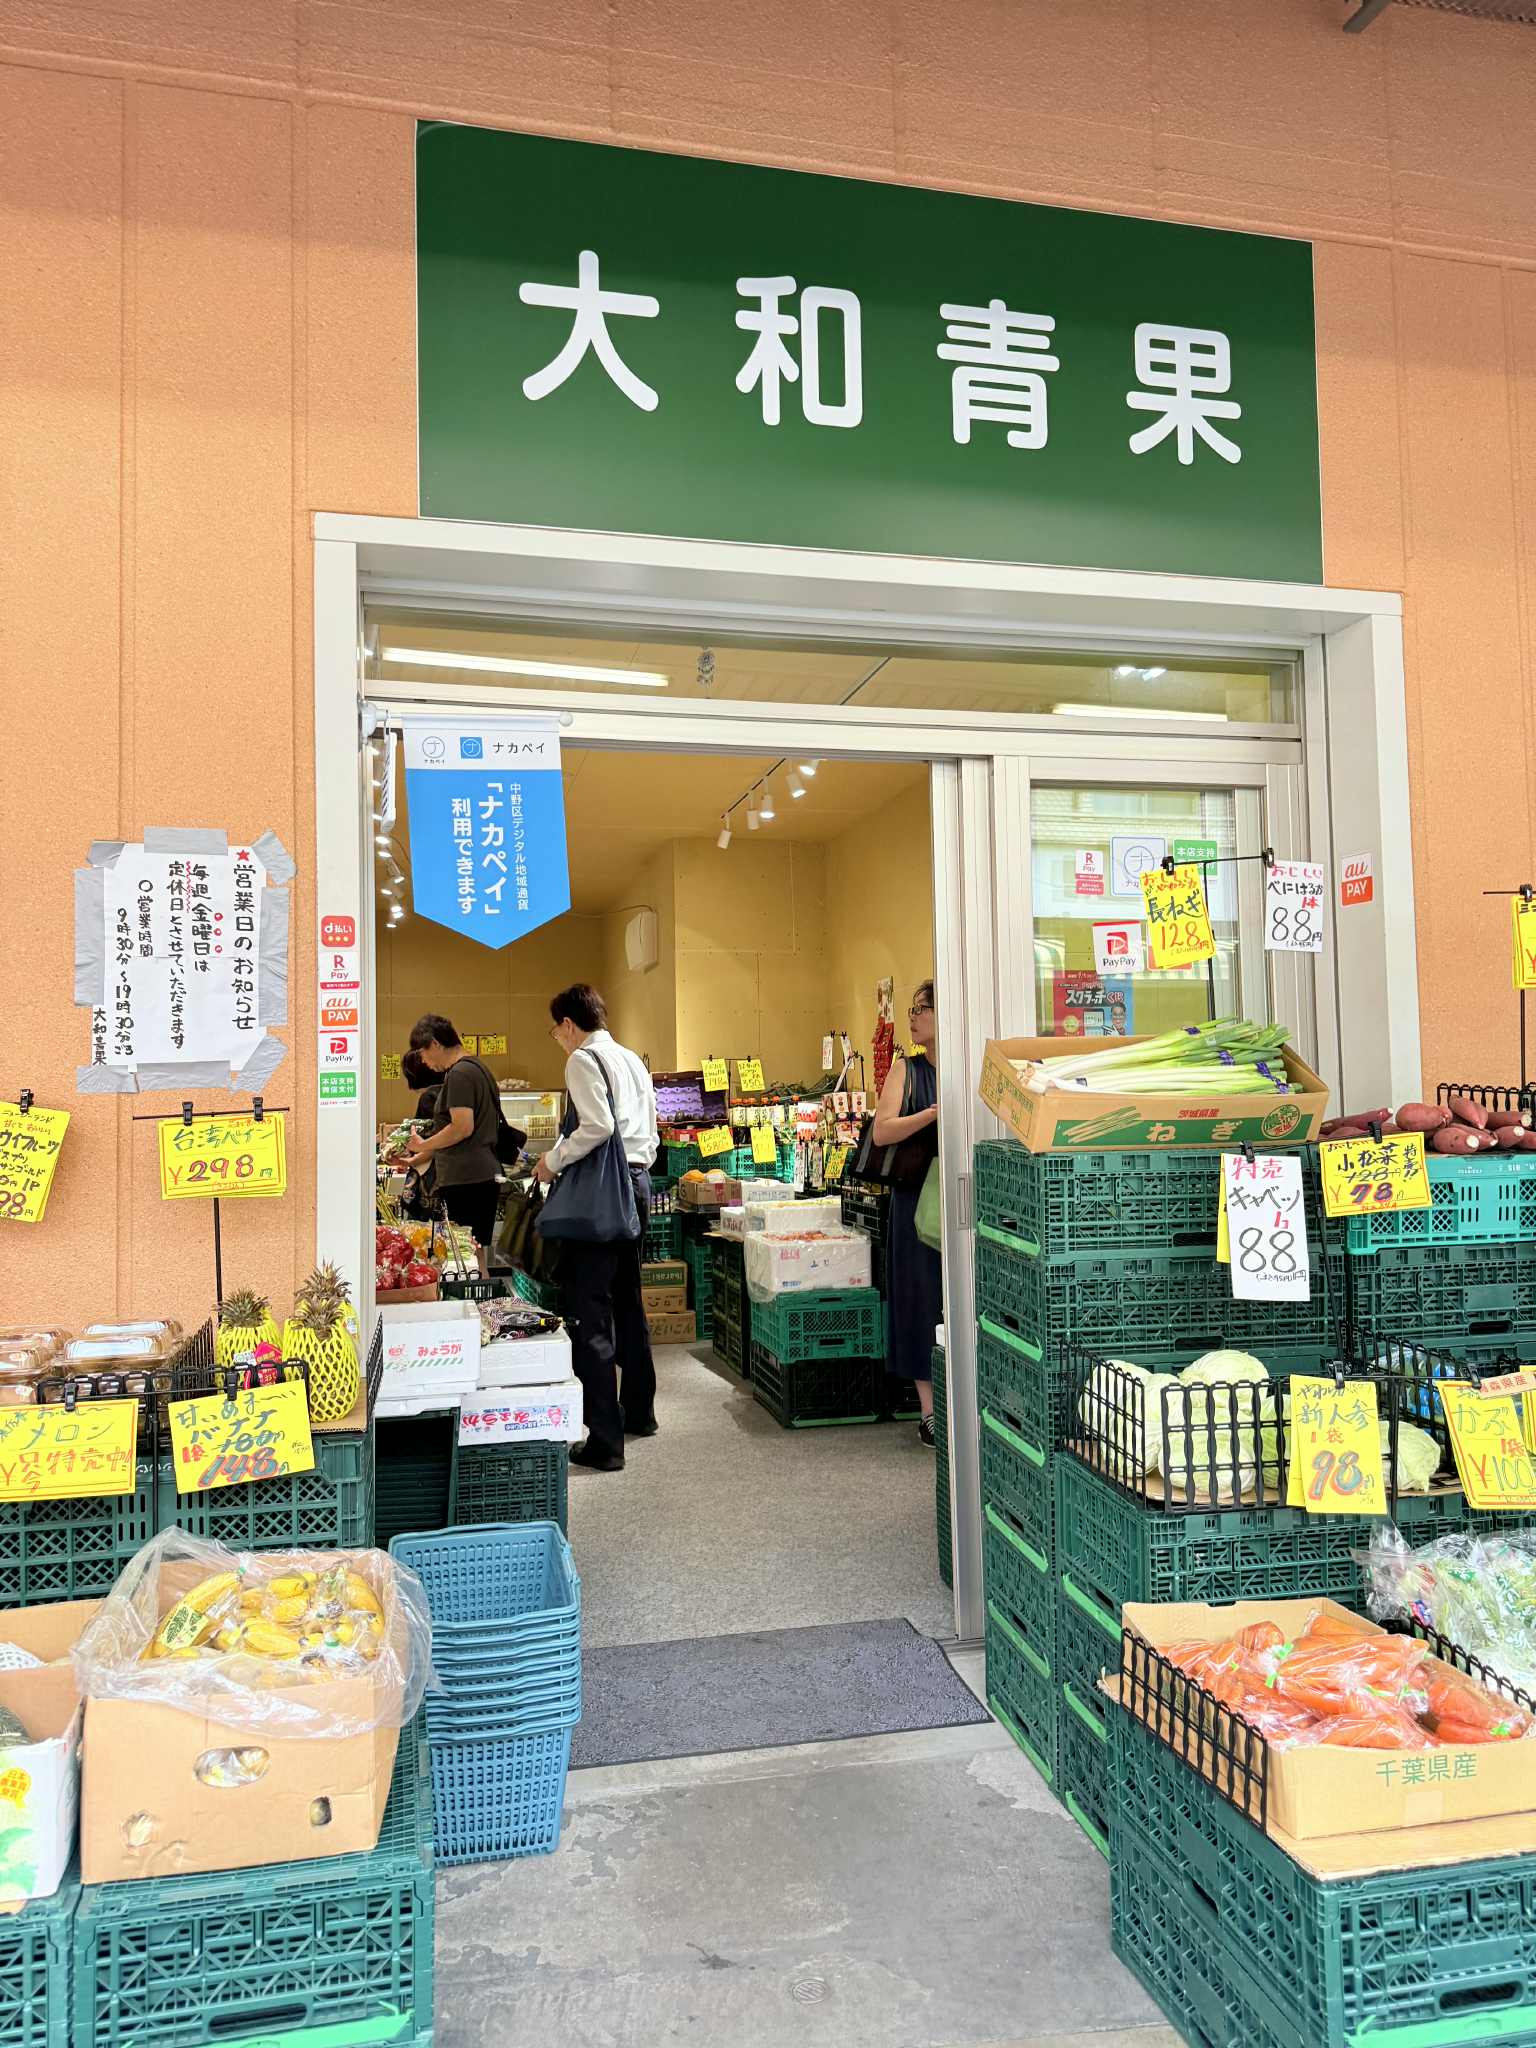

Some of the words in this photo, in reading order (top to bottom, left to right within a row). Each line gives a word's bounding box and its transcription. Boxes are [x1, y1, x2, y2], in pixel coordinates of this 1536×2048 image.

[518, 249, 1242, 466] 大和青果
[492, 742, 545, 754] ナカペイ
[451, 798, 477, 914] 利用できます
[479, 782, 508, 915] 「ナカペイ」
[510, 783, 529, 910] 中野区デジタル地域通貨
[1176, 847, 1216, 858] 本店支持
[1344, 862, 1368, 878] au
[1268, 880, 1323, 895] べにはるか
[1346, 880, 1368, 897] PAY
[192, 863, 211, 972] 毎週金曜日は
[1147, 889, 1204, 923] 長ねぎ
[324, 922, 352, 933] d払い
[1161, 921, 1210, 951] 128円
[1272, 907, 1322, 942] 88円
[167, 861, 186, 1049] 定休日とさせていただきます
[232, 864, 256, 1031] 営業日のお知らせ
[334, 954, 345, 968] R
[1103, 957, 1136, 966] PayPay
[330, 971, 349, 980] Pay
[326, 998, 352, 1008] au
[328, 1011, 352, 1021] PAY
[93, 1008, 107, 1065] 大和青果
[325, 1055, 353, 1064] PayPay
[1146, 1120, 1244, 1142] ねぎ
[1232, 1157, 1286, 1180] 特売
[1338, 1143, 1400, 1171] 小松菜
[1229, 1185, 1300, 1213] キャベツ
[417, 1343, 462, 1357] みょうが
[190, 1408, 279, 1445] バナナ
[1296, 1399, 1377, 1432] 新人参
[19, 1422, 115, 1451] メロン
[198, 1445, 290, 1488] 148円
[1376, 1752, 1477, 1787] 千葉県産
